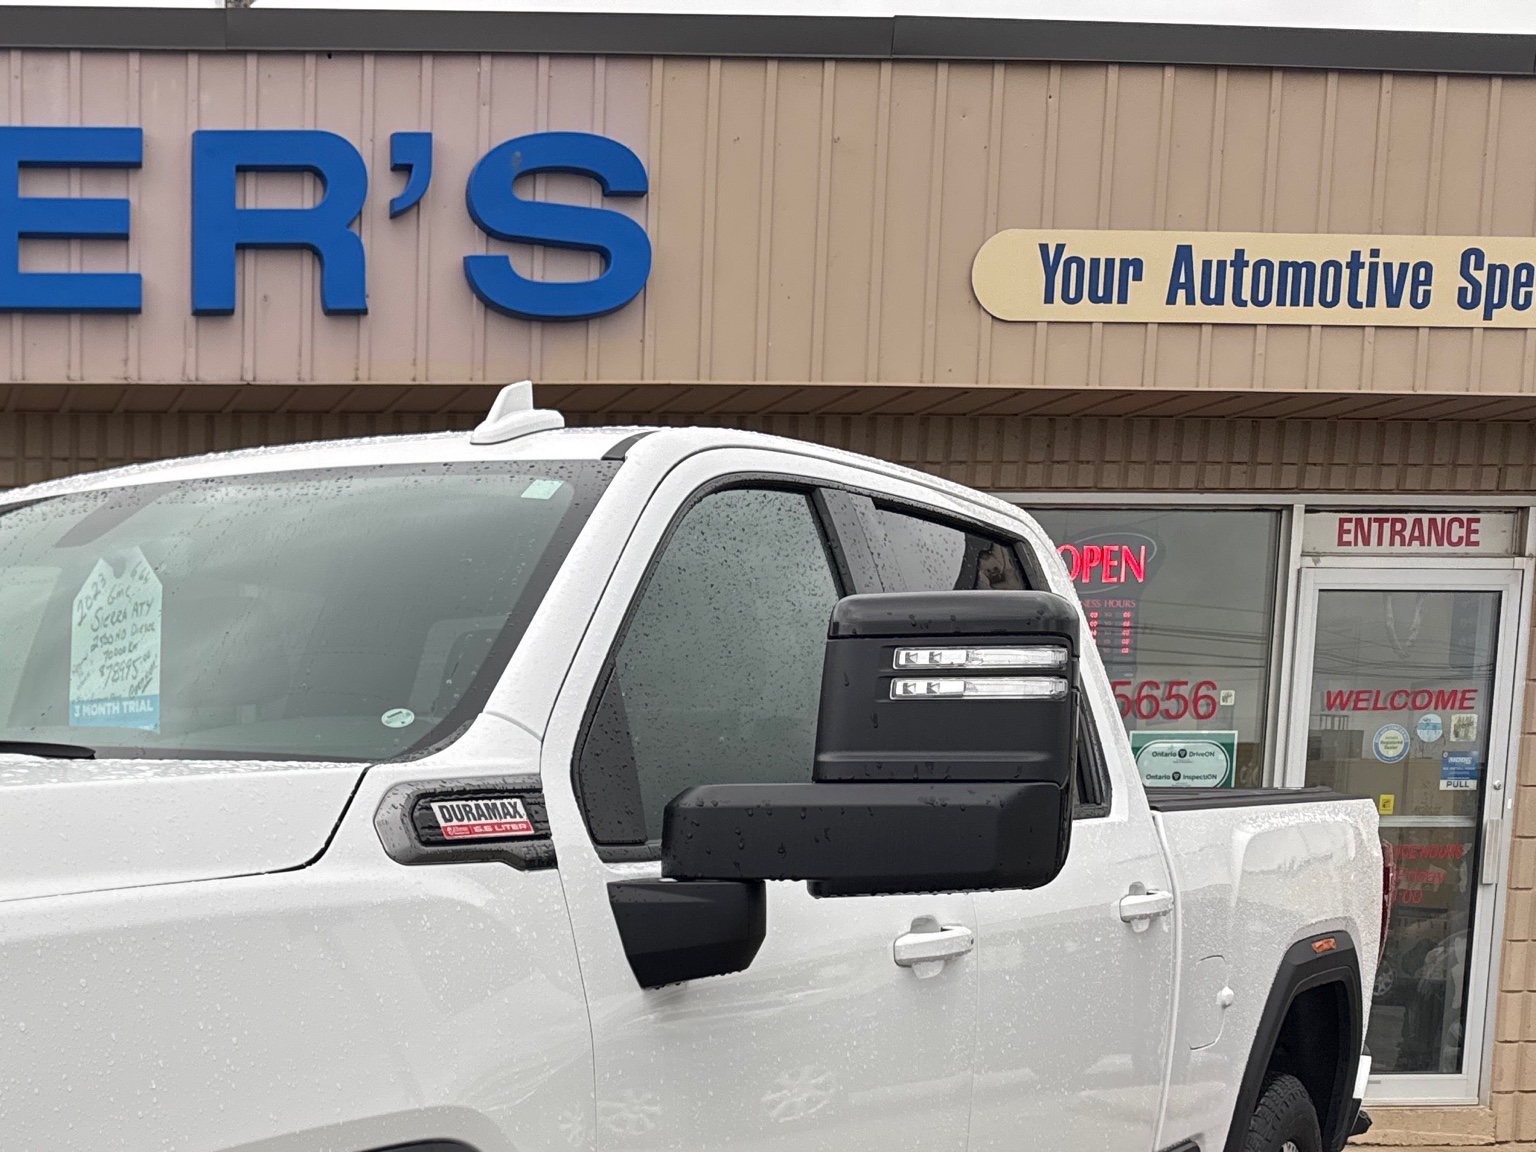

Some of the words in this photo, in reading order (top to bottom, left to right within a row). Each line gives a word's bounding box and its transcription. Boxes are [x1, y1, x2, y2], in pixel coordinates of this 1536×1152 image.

[1038, 243, 1144, 305] Your
[1165, 244, 1433, 311] Automotive
[1457, 247, 1535, 321] Spe
[1337, 517, 1481, 547] ENTRANCE
[1055, 544, 1147, 584] OPEN
[76, 572, 107, 627] 2023
[1104, 599, 1136, 608] HOURS
[74, 704, 81, 718] 3
[82, 701, 120, 716] MONTH
[122, 699, 154, 714] TRIAL
[1111, 680, 1217, 720] 5656
[1326, 689, 1478, 711] WELCOME
[438, 801, 524, 823] DURAMAX
[494, 823, 527, 831] LITER
[1419, 843, 1463, 859] HOURS
[1395, 866, 1447, 887] Friday
